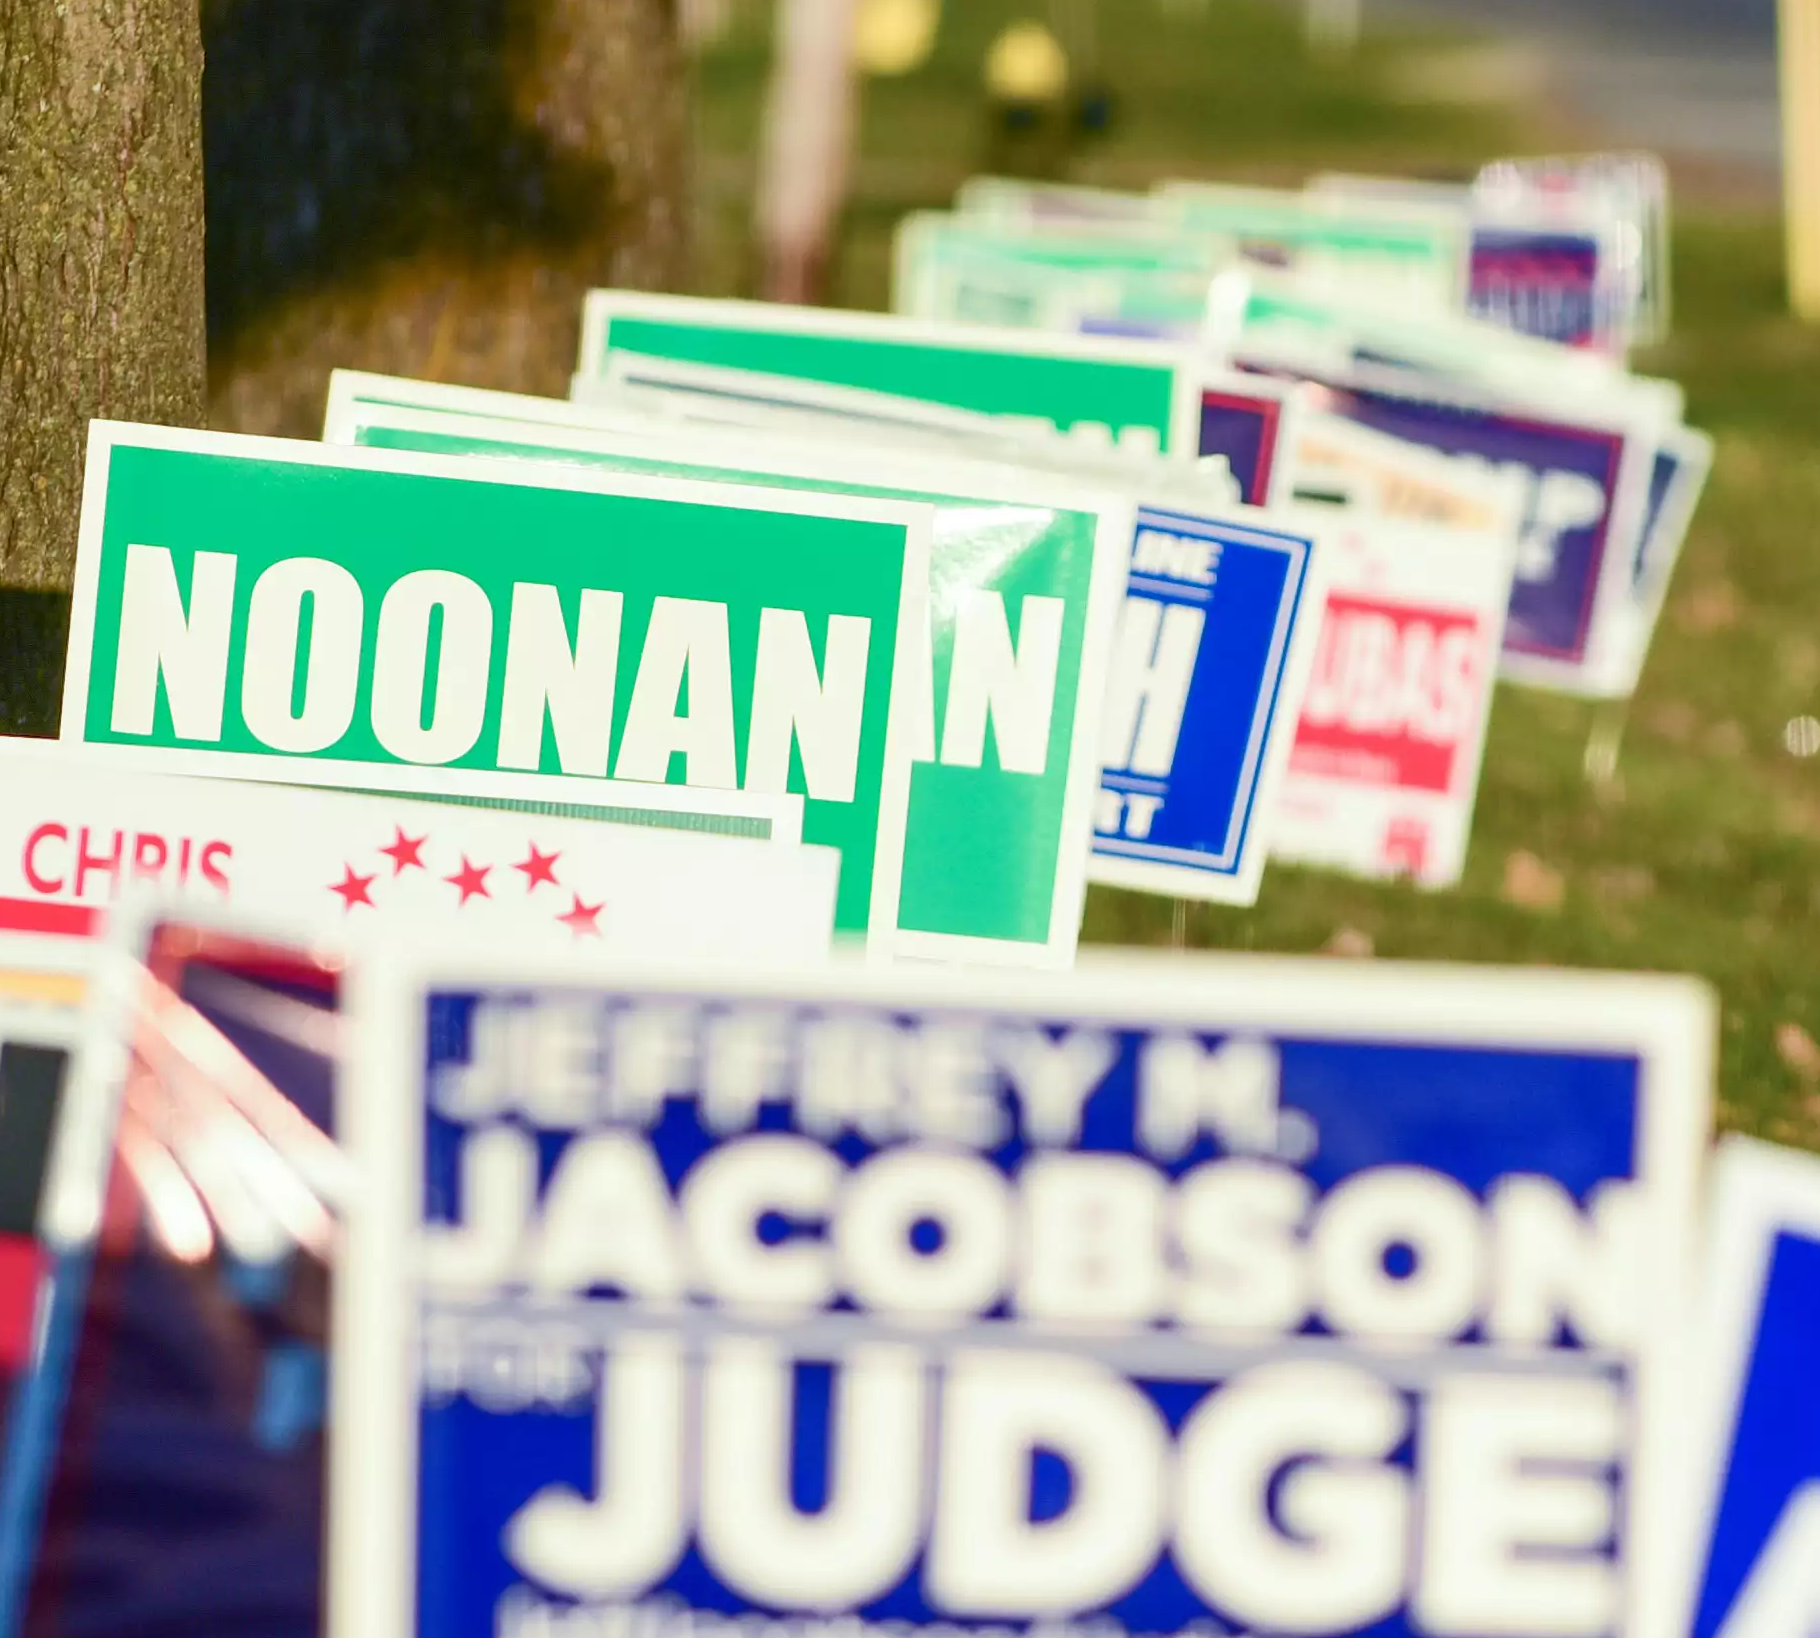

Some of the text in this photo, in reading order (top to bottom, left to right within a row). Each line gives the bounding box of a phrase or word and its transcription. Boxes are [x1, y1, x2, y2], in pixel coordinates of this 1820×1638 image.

[111, 544, 871, 802] NOONAN
[22, 823, 233, 896] CHRIS
[431, 1001, 1117, 1153] JEFFREY
[420, 1127, 1644, 1349] JACOBSON
[420, 1317, 599, 1415] FOR
